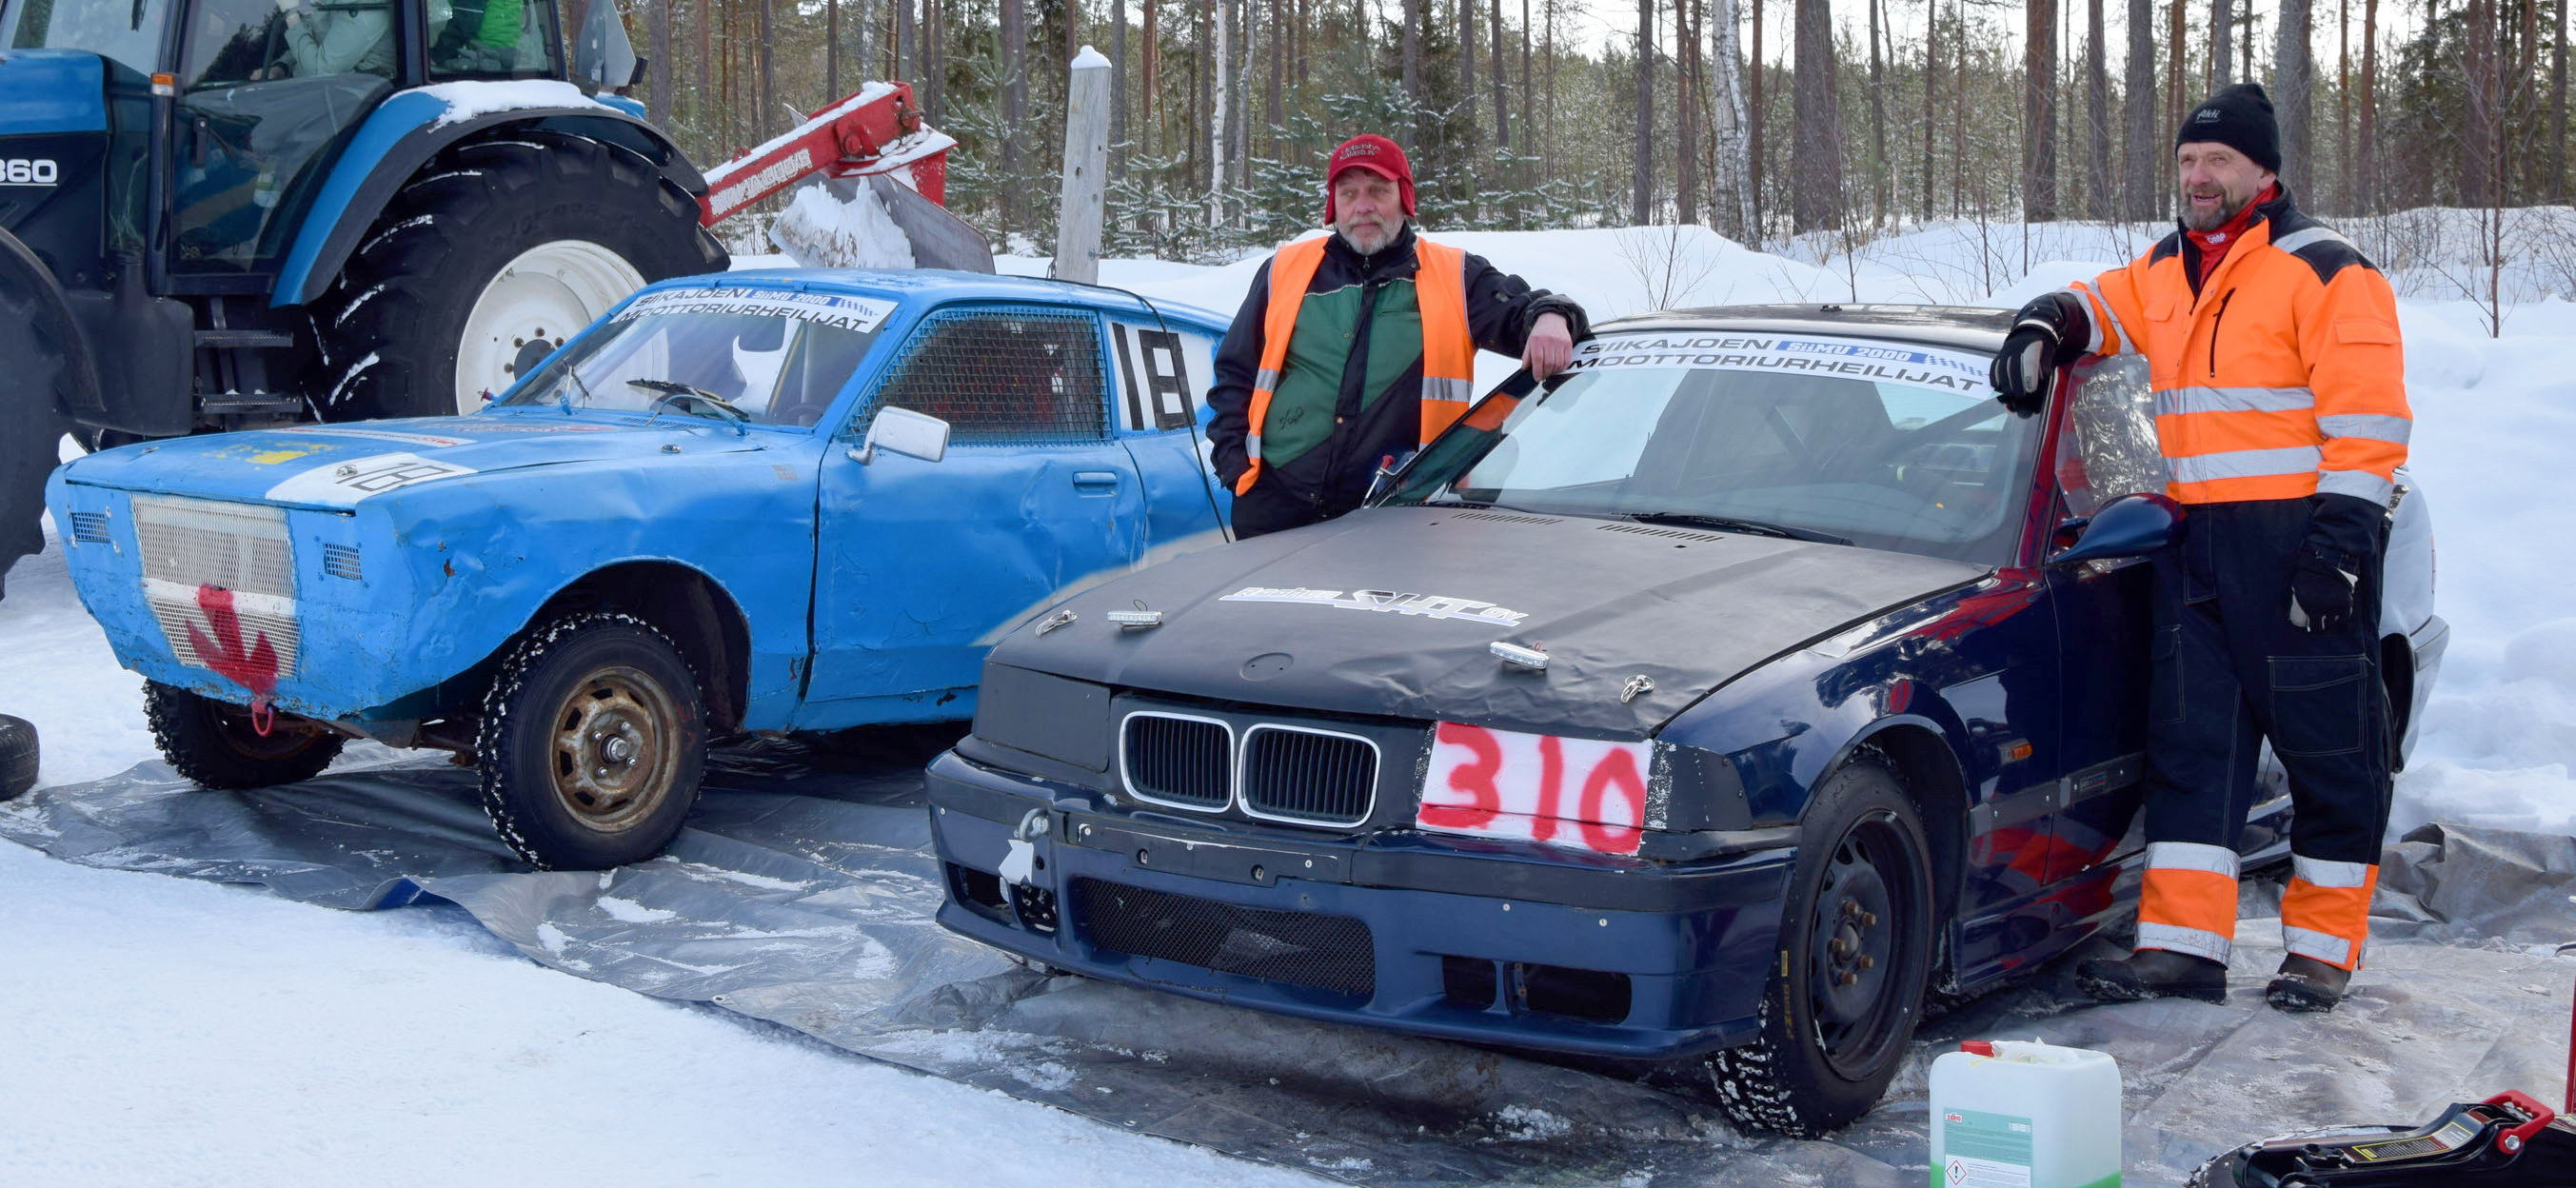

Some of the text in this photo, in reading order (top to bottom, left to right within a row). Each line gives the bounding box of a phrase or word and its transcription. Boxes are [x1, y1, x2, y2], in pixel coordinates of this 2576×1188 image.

[0, 159, 57, 183] 60
[636, 288, 746, 307] SIIKAJOEN
[792, 293, 831, 306] 2000
[619, 304, 869, 331] MOOTTORIURHEILIJAT
[1581, 338, 1773, 355] SIIKAJOEN
[1853, 347, 1912, 363] 2000
[1112, 323, 1197, 432] 18
[1568, 354, 1984, 392] MOOTTORIURHEILIJAT
[335, 463, 456, 492] 18
[1417, 721, 1647, 854] 310
